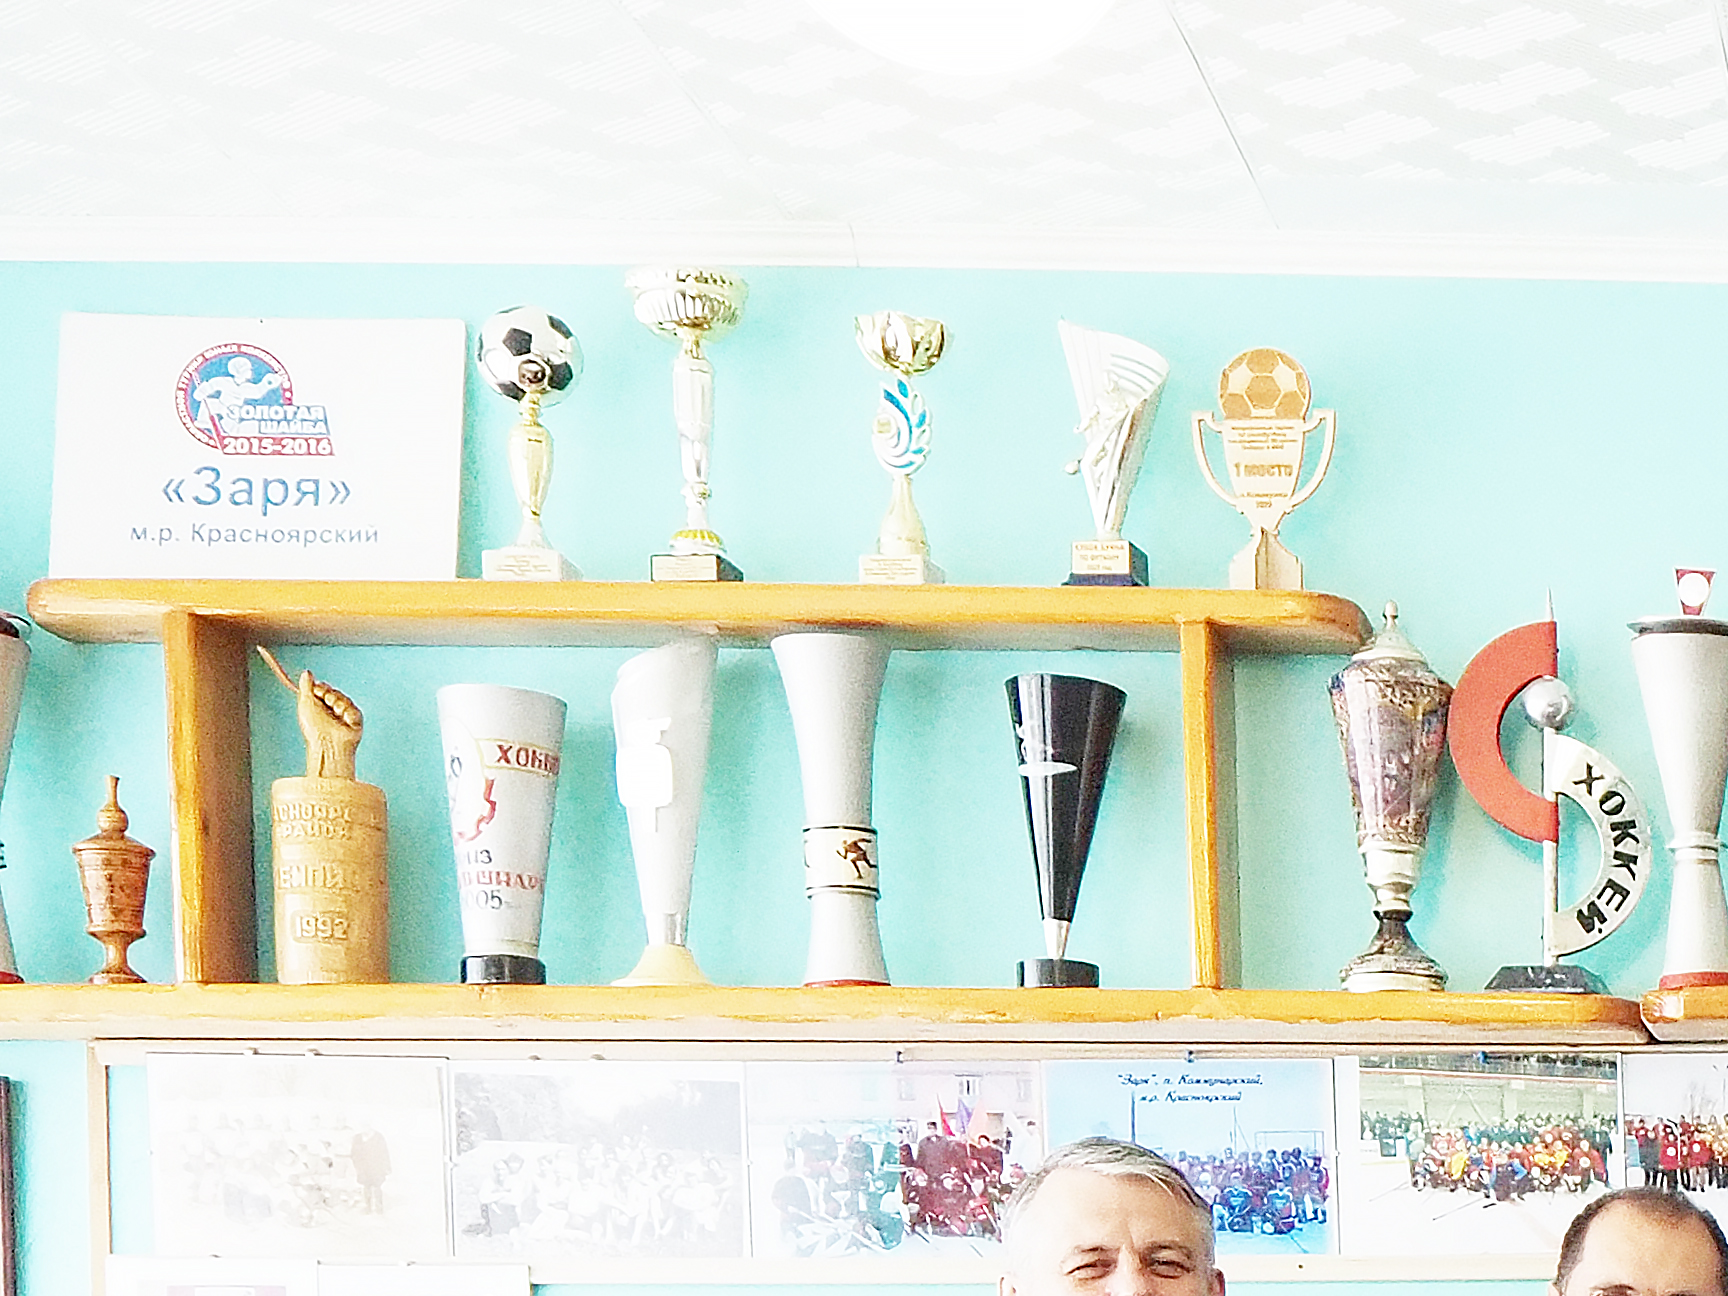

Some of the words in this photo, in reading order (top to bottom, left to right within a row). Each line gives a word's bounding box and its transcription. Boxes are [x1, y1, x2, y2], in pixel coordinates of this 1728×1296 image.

[226, 405, 325, 420] ЗОЛОТАЯ
[260, 420, 327, 434] ШАЙБА
[223, 437, 332, 455] 2015-2016
[161, 465, 351, 517] «Заря»
[130, 526, 180, 547] м.р.
[191, 522, 379, 548] Красноярский
[1572, 760, 1641, 938] ХОККЕЙ
[294, 914, 349, 939] 1992
